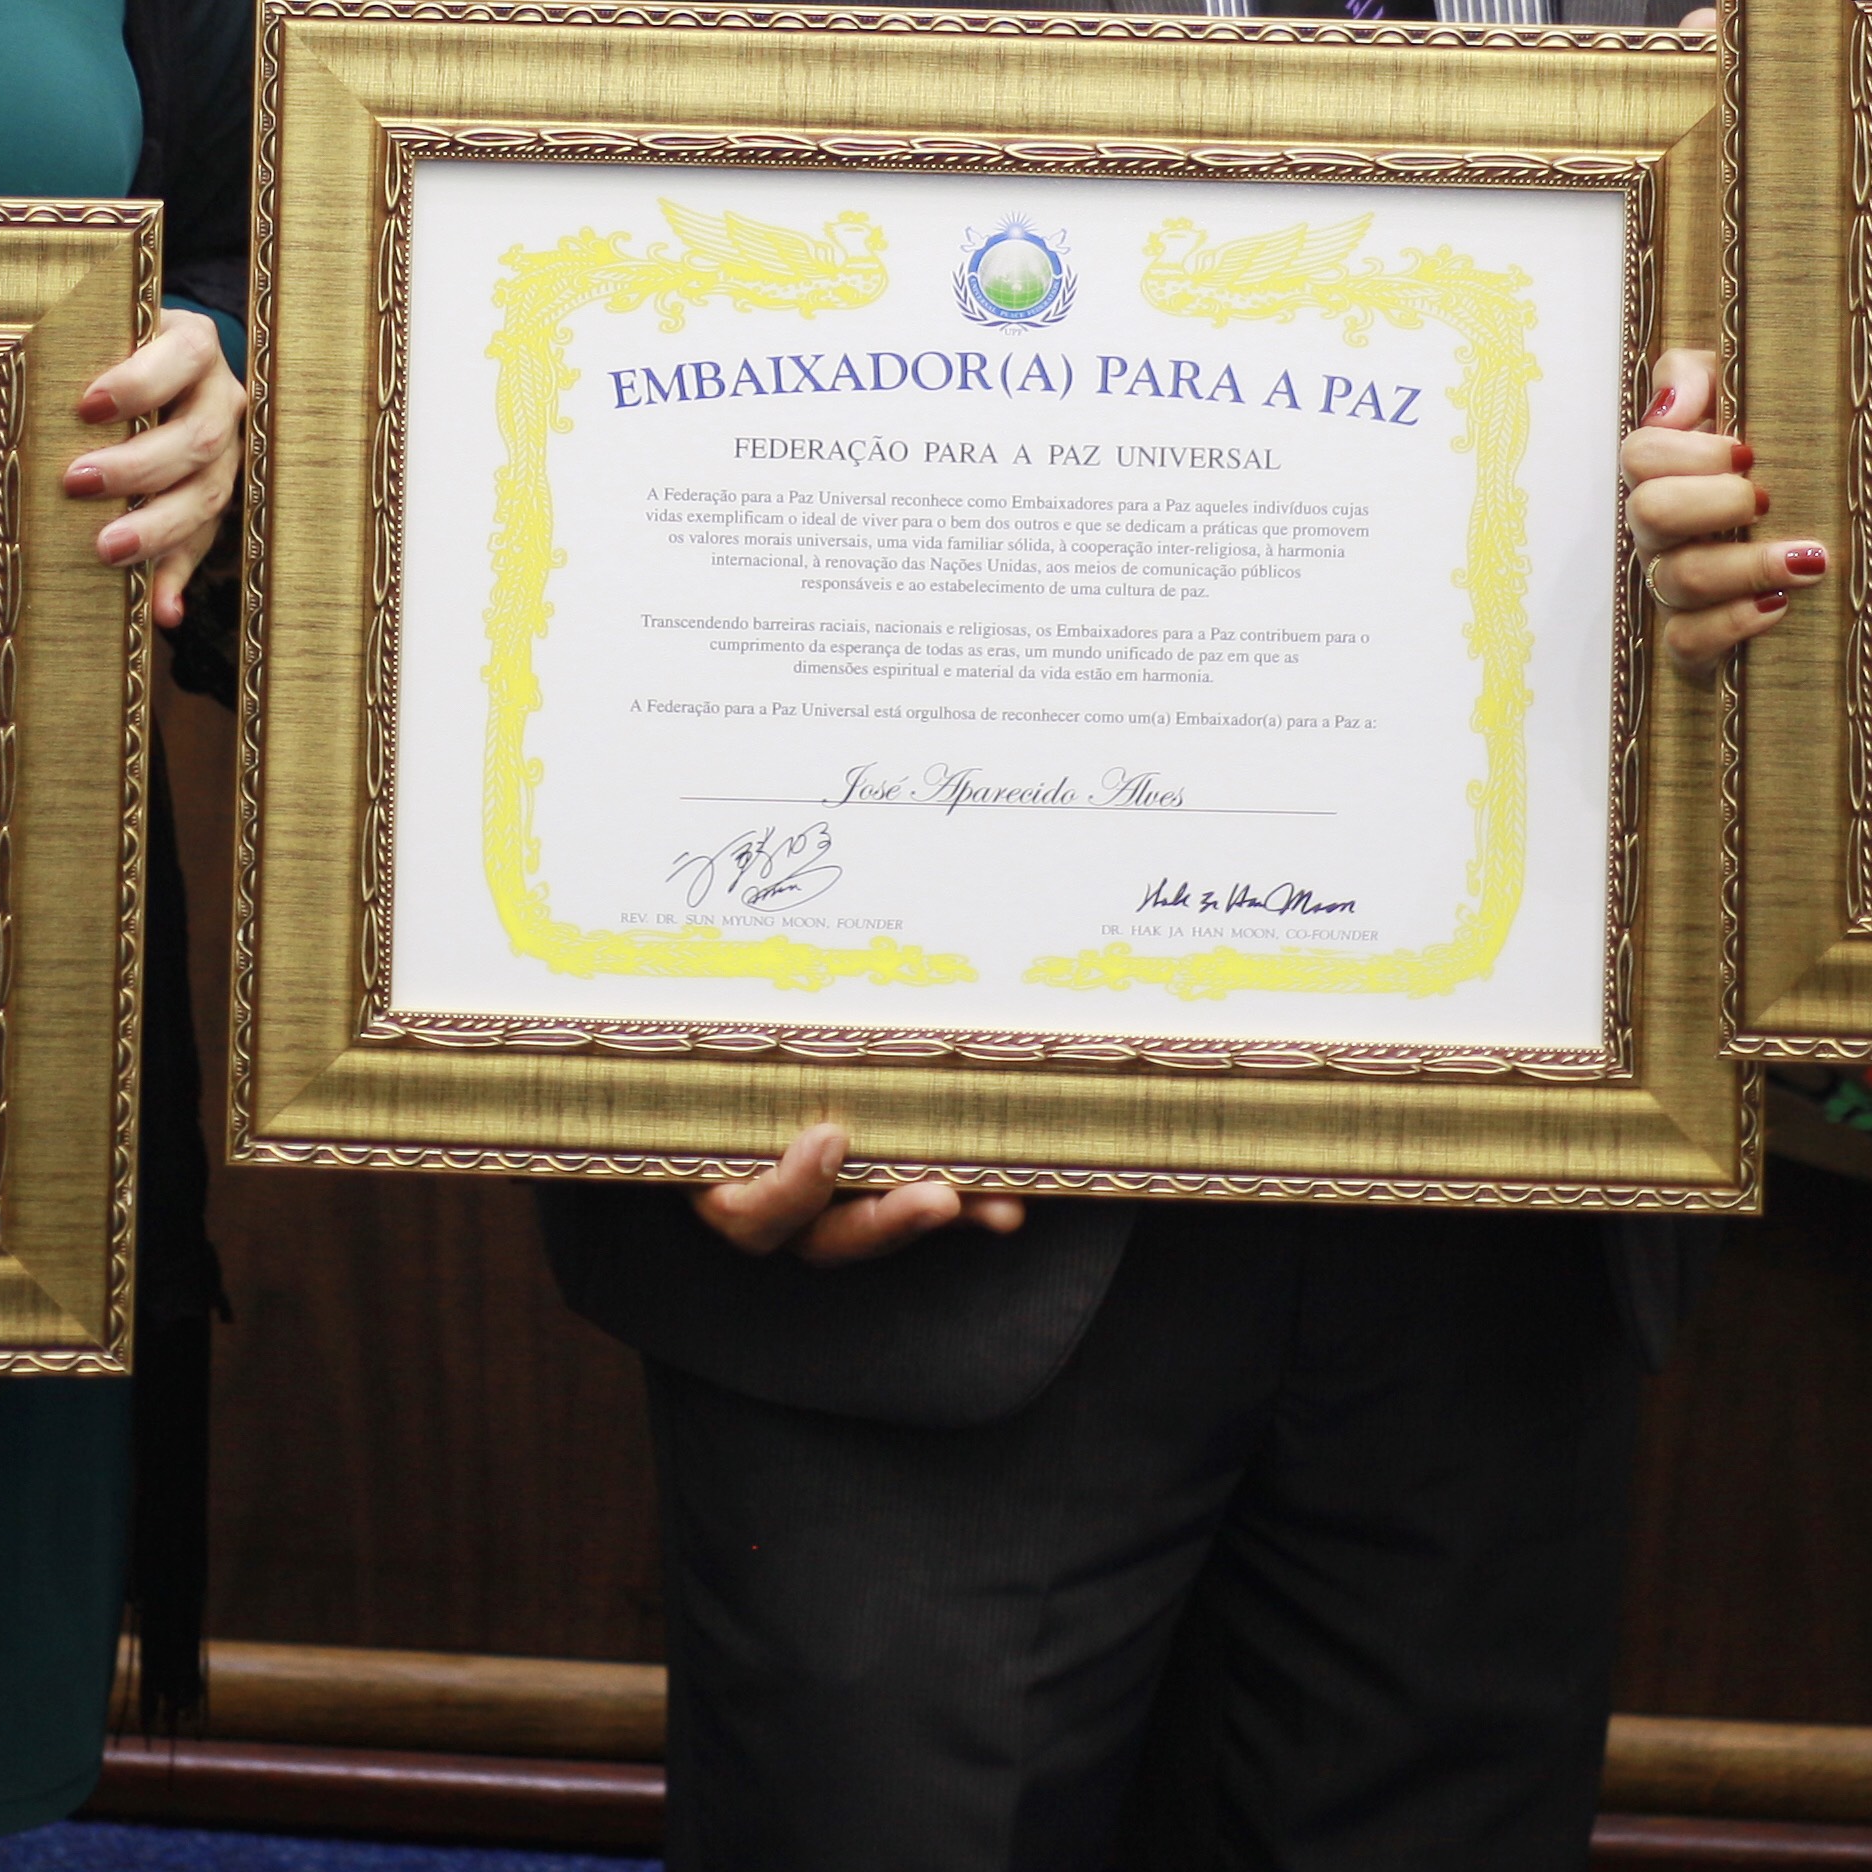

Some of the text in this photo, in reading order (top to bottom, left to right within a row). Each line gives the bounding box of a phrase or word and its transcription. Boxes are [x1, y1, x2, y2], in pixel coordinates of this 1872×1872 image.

[608, 351, 1422, 426] EMBAIXADOR(A) PARA A PAZ
[733, 435, 1281, 470] FEDERAÇÃO PARA A PAZ UNIVERSAL
[801, 576, 1210, 601] responsáveis e ao estabelecimento de uma cultura de paz.
[640, 613, 1370, 648] Transcendendo barreiras raciais, nacionais e religiosas, os Embaixadores para a Paz contribuem para o
[822, 762, 1185, 816] José Aparecido Alves
[620, 913, 903, 930] REV. DR. SUN MYUNG MOON, FOUNDER
[1101, 925, 1378, 941] DR. HAK JA HAN MOON, CO-FOUNDER
